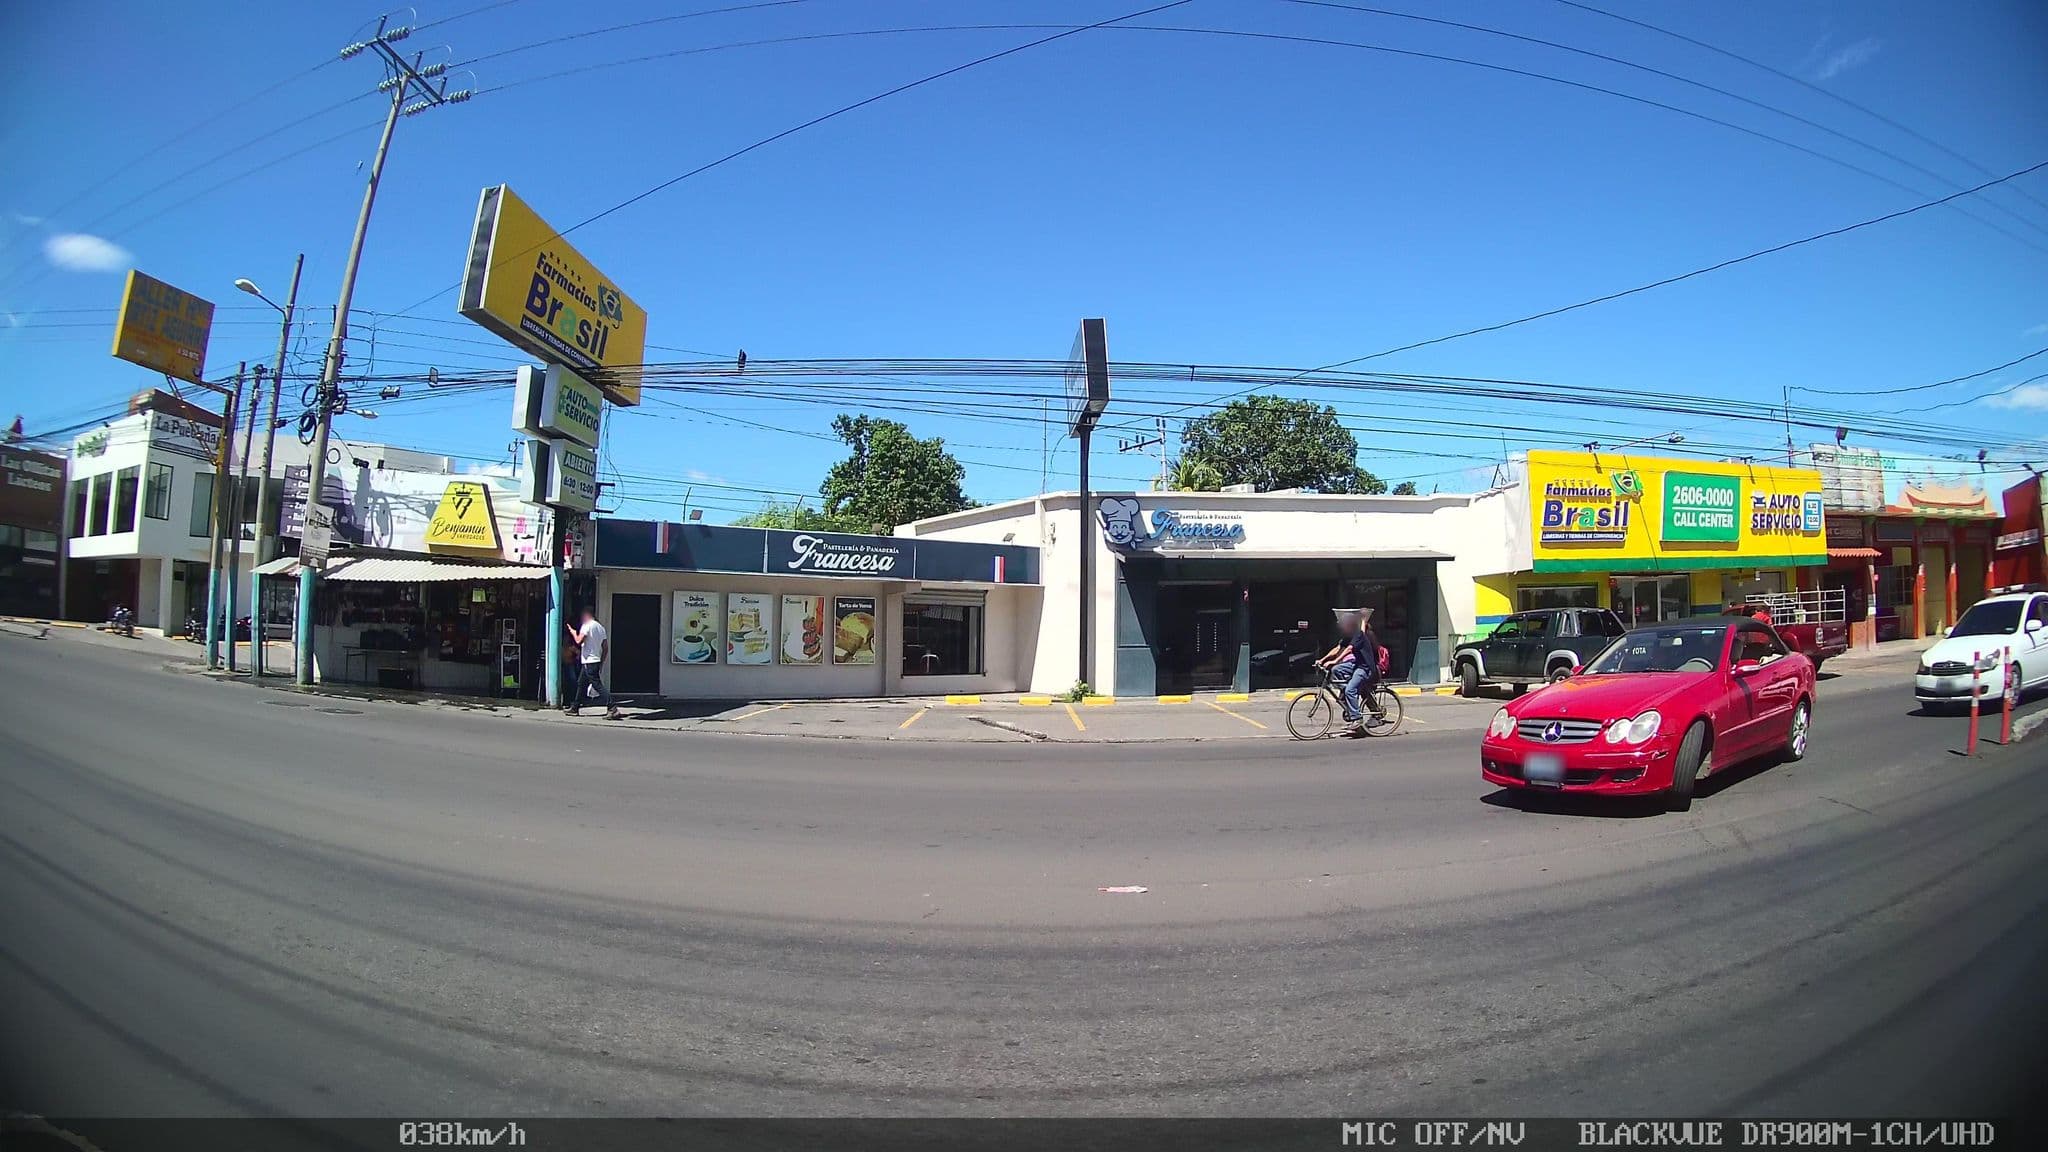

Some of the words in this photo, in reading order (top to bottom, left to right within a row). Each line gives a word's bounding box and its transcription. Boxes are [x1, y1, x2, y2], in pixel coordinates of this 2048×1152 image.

[536, 251, 597, 313] Farmacias
[525, 271, 609, 360] Brasil
[566, 388, 587, 409] AUTO
[155, 415, 170, 432] La
[564, 403, 599, 432] SERVICIO
[565, 453, 595, 476] ABIERTO
[580, 481, 594, 494] 12:00
[1546, 483, 1612, 496] Farmacias
[1673, 486, 1734, 507] 2606-0000
[1769, 494, 1801, 509] AUTO
[1149, 507, 1243, 539] Francesa
[1543, 500, 1629, 527] Brasil
[1673, 512, 1697, 527] CALL
[1699, 512, 1734, 528] CENTER
[1752, 513, 1802, 529] SERVICIO
[788, 534, 895, 571] Francesa
